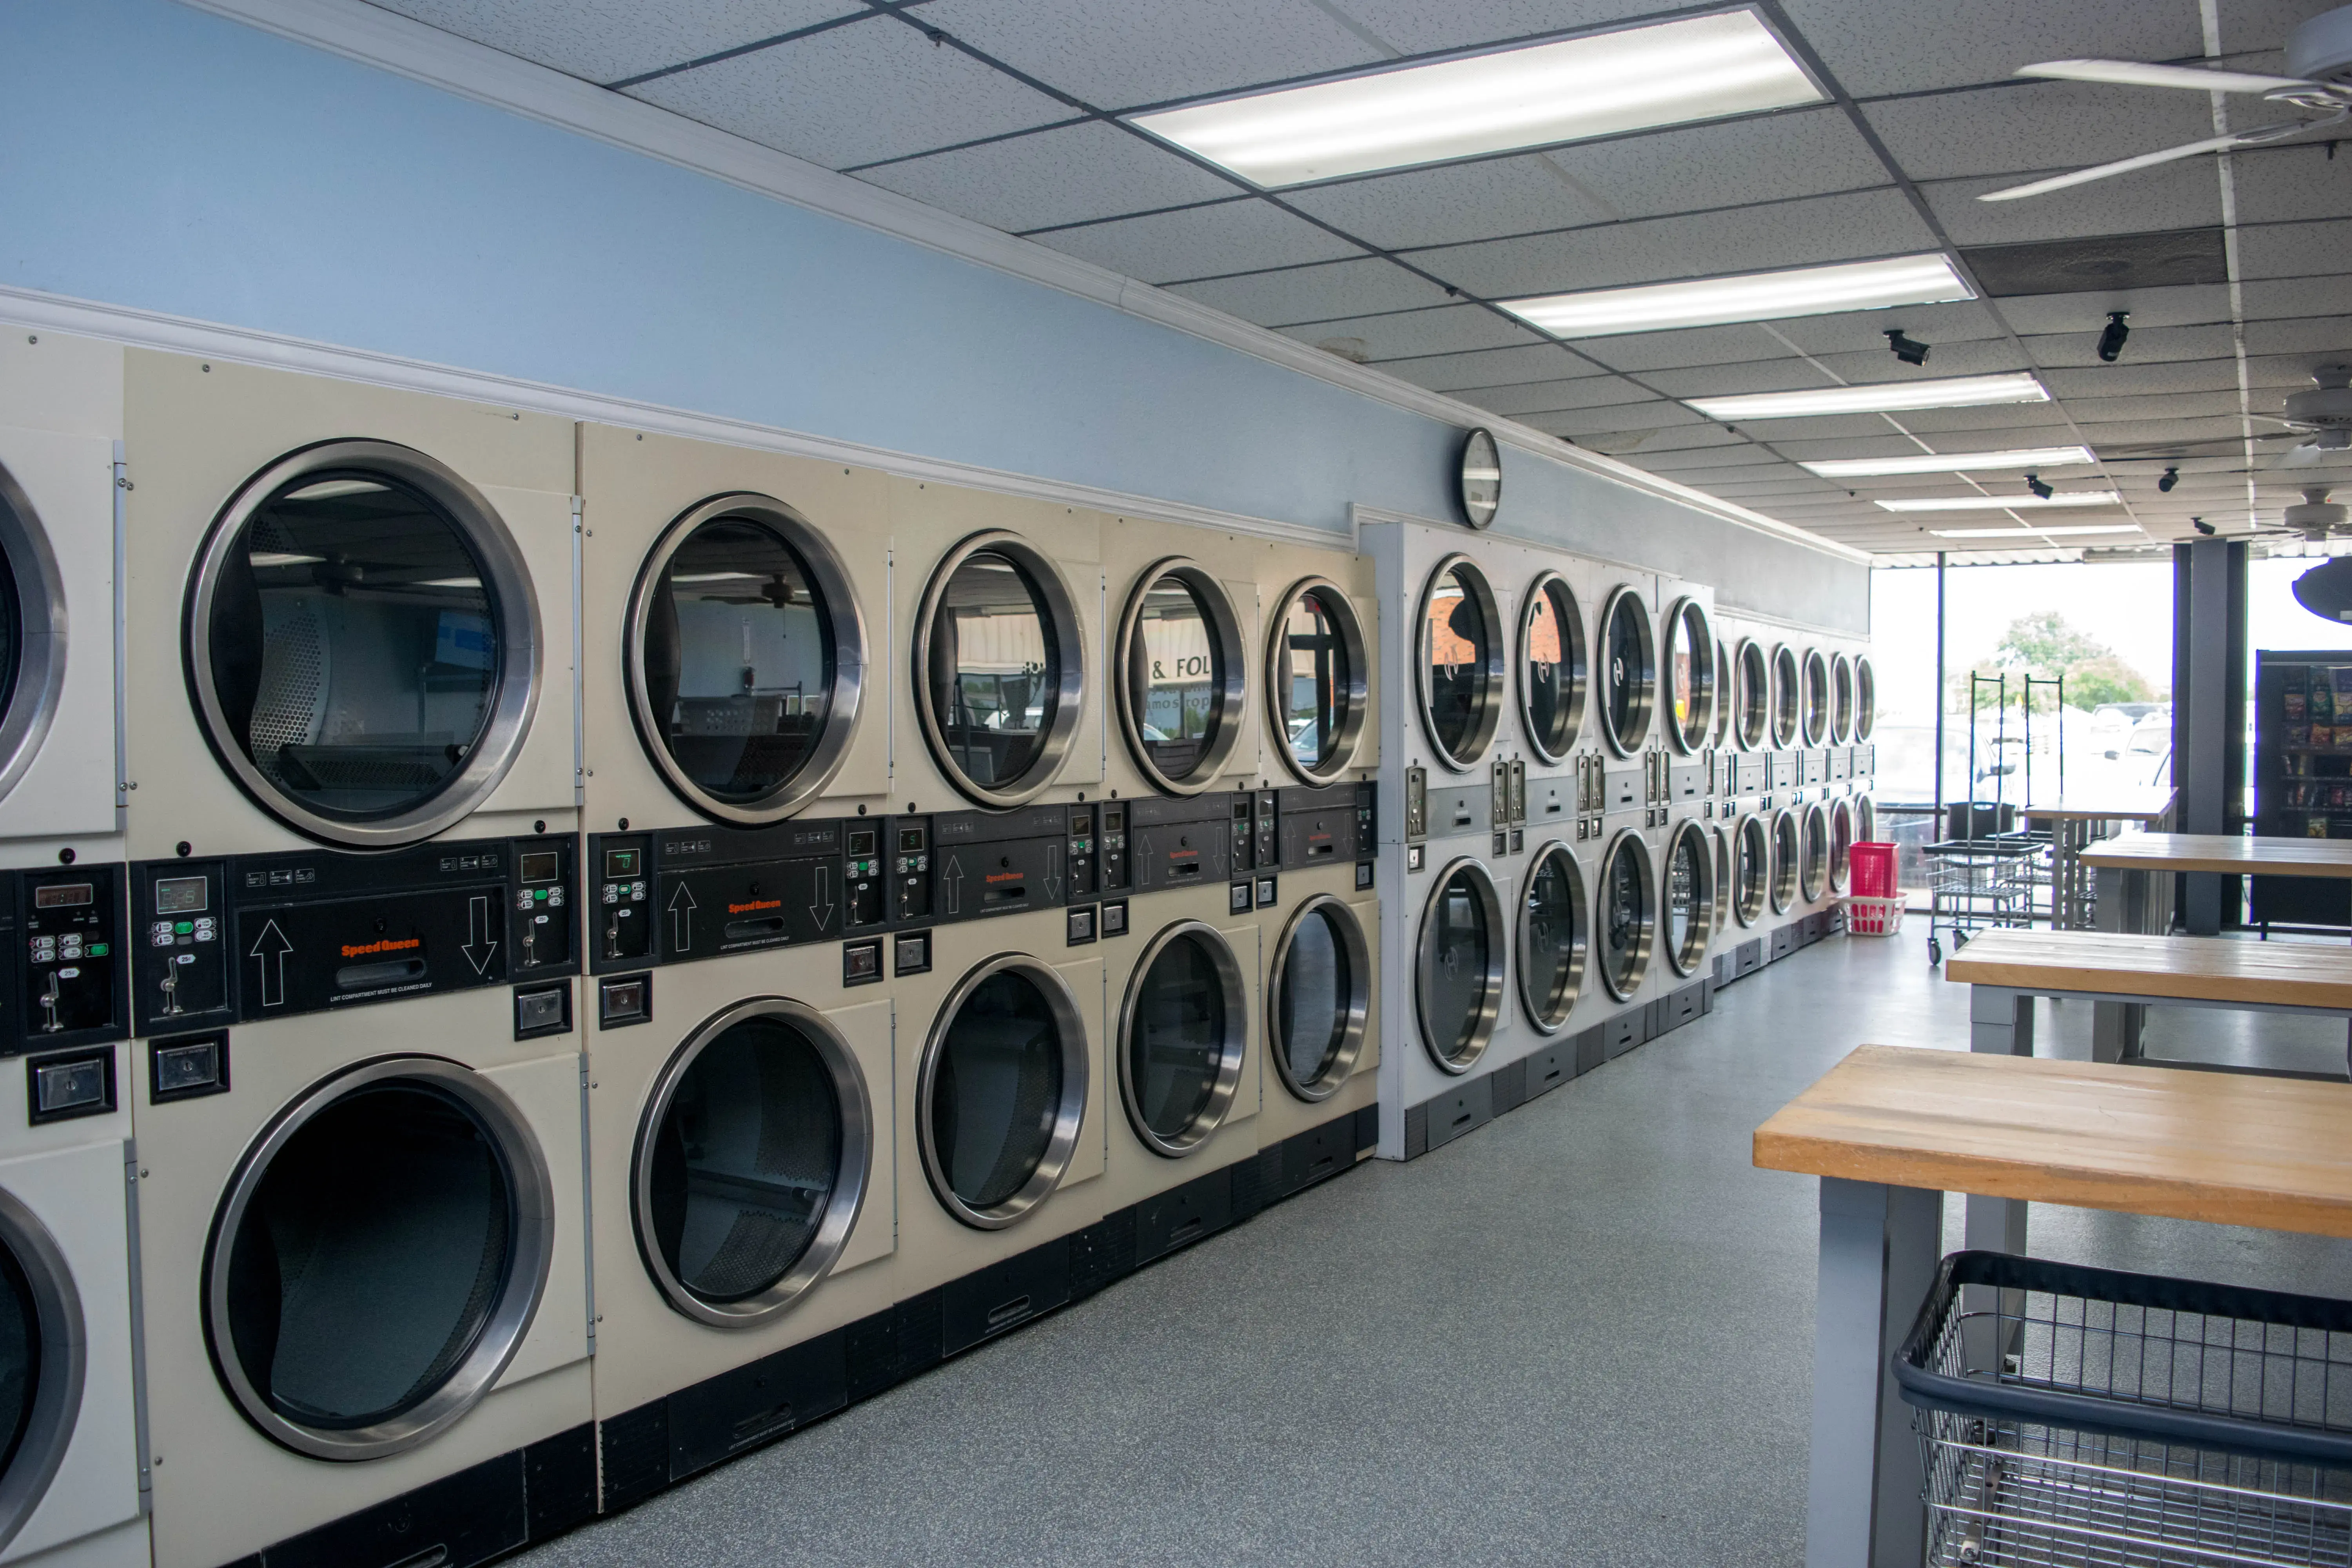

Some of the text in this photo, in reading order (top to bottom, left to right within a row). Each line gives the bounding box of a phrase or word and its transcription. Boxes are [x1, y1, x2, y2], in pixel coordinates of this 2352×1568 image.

[1152, 661, 1166, 679] &
[728, 900, 781, 914] Speed Queen
[341, 938, 419, 957] Speed Queen
[341, 991, 376, 1000] COMPARTMENT
